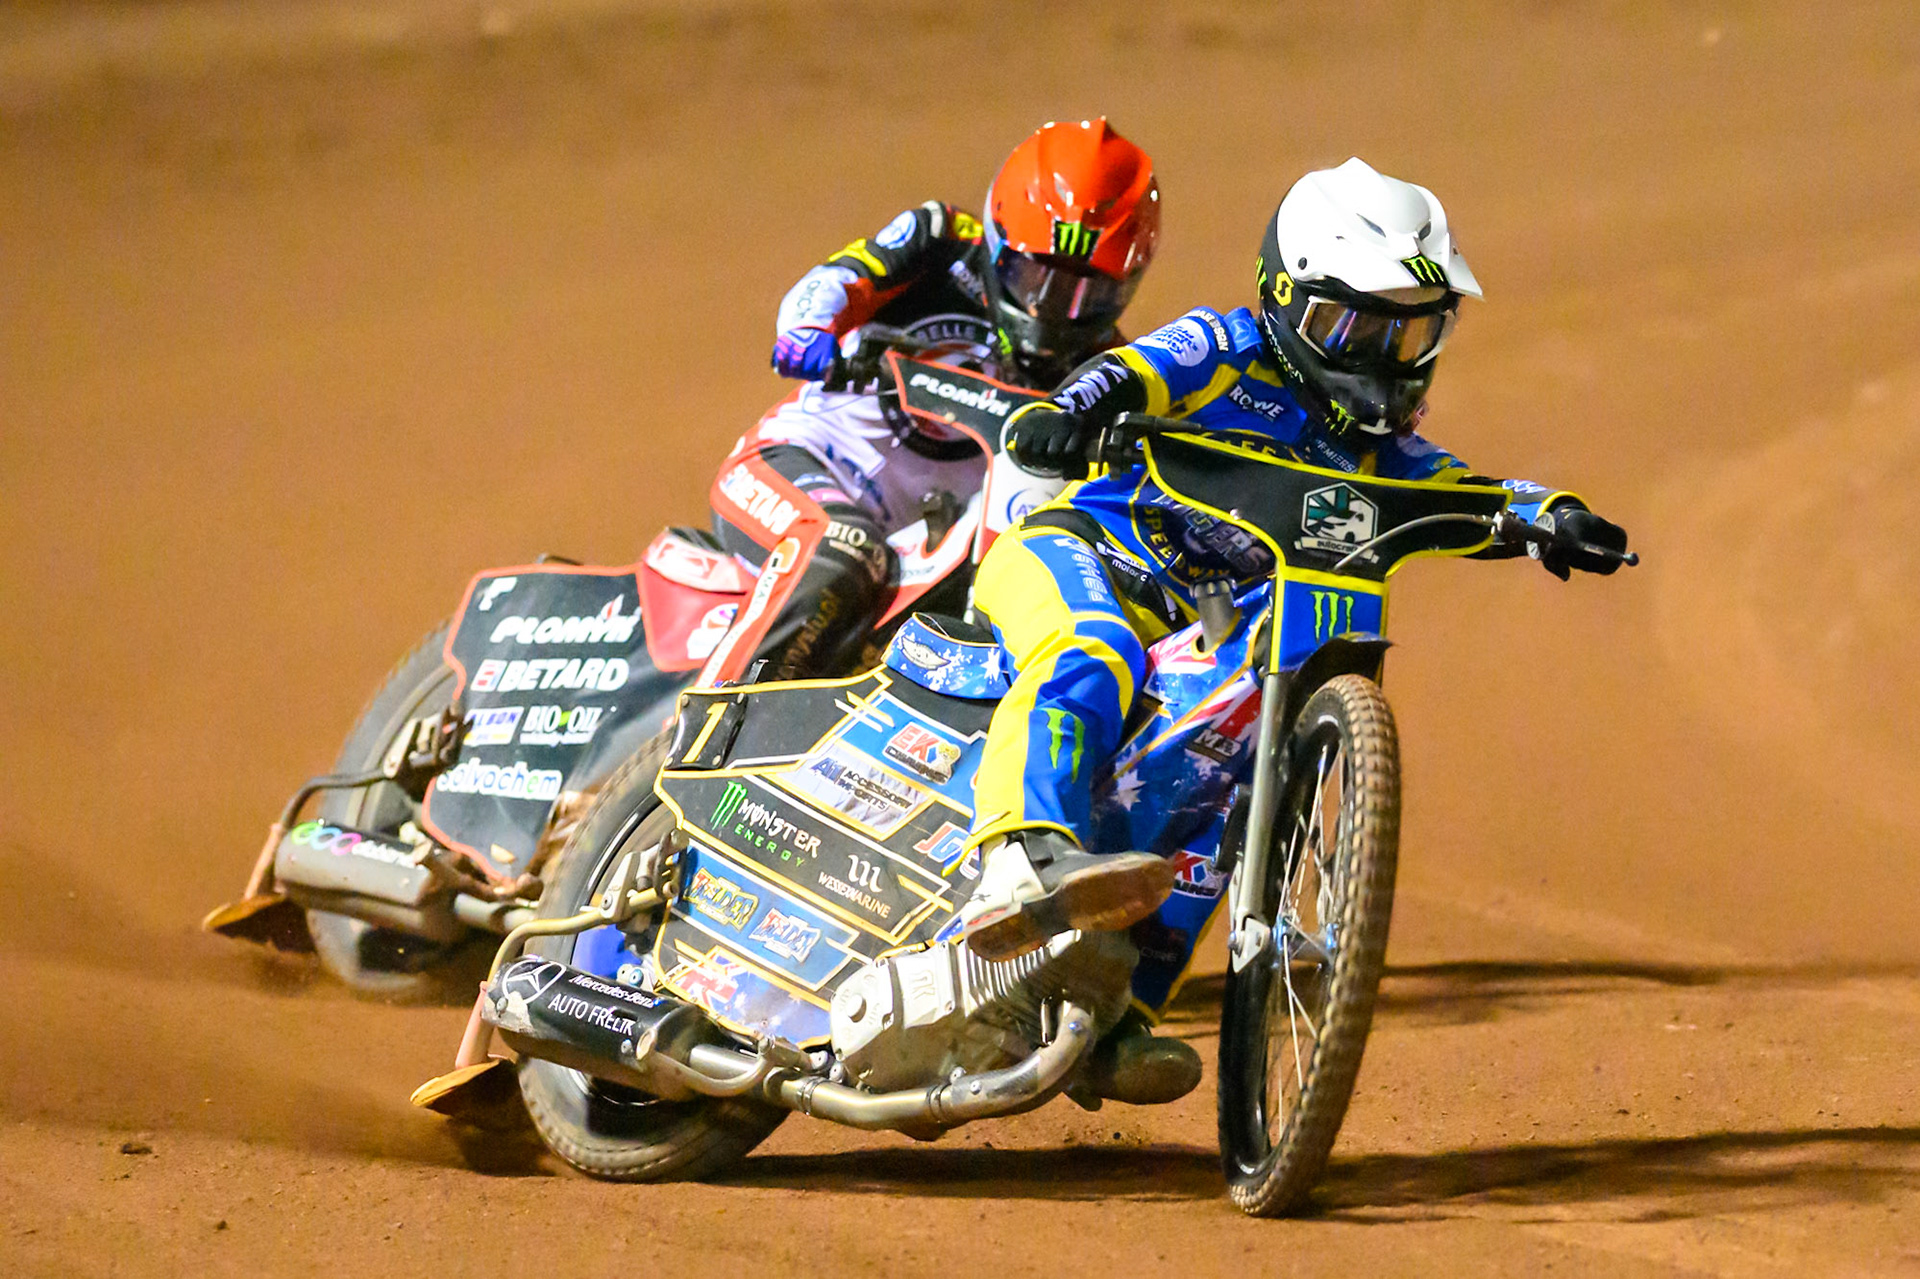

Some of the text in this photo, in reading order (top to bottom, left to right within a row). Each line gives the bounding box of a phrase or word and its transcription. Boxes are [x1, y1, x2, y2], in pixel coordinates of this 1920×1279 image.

[1229, 384, 1284, 418] ROWE
[497, 658, 629, 691] BETARD
[681, 702, 728, 763] 1
[891, 724, 939, 763] EK
[844, 770, 913, 810] ACCESSORY
[734, 823, 805, 868] ENERGY
[548, 993, 587, 1020] AUTO
